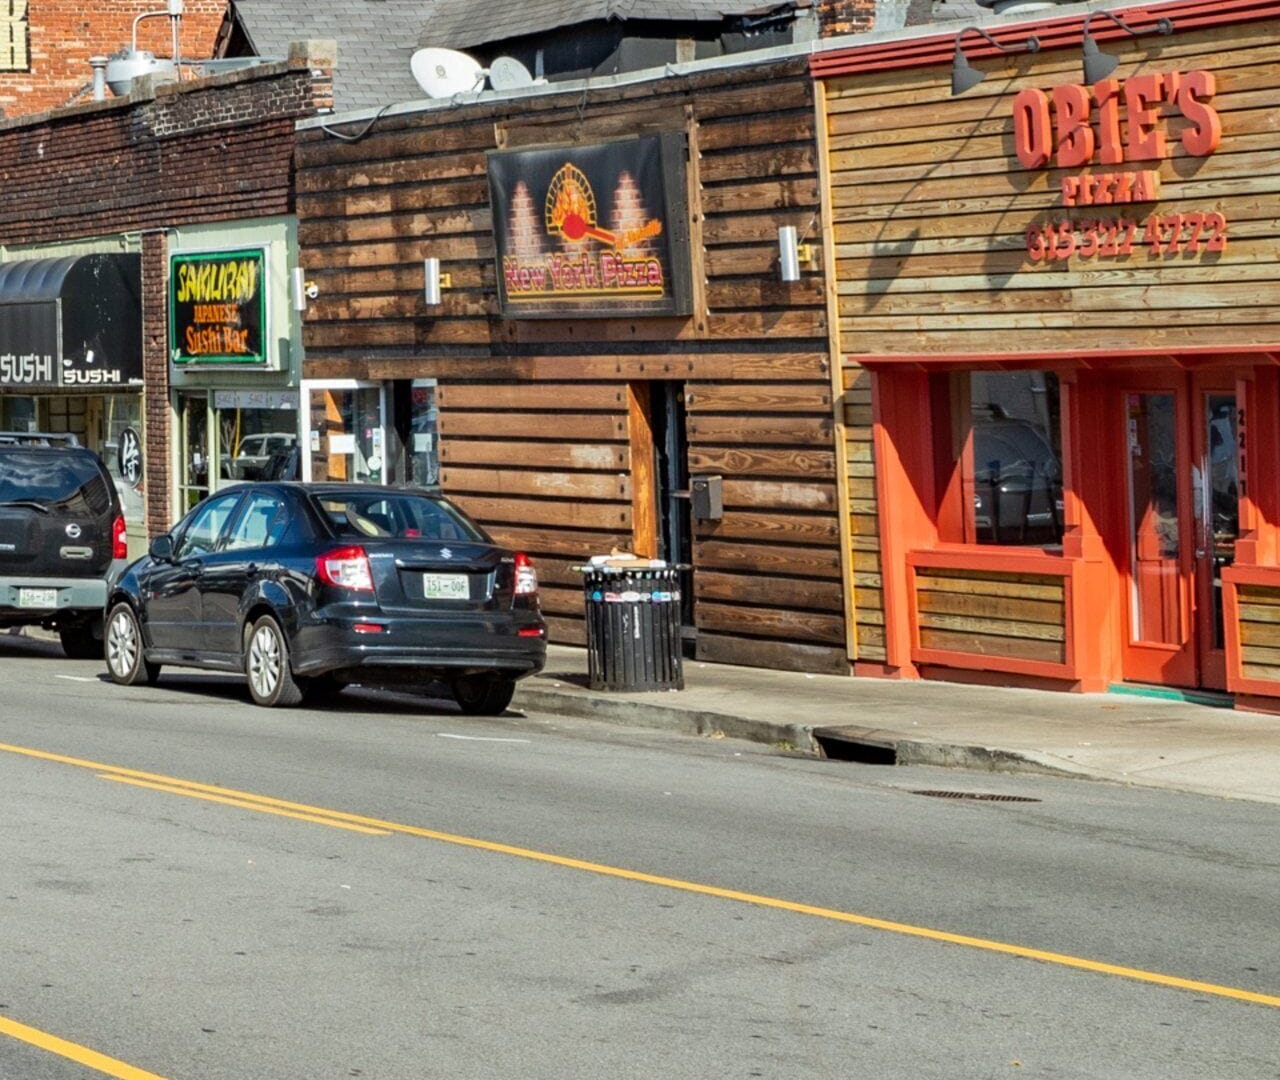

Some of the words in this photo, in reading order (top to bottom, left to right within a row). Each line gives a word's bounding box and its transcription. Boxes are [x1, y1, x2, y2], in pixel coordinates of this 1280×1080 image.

[1013, 70, 1222, 169] OBIE'S
[1061, 170, 1161, 207] PIZZA
[1026, 219, 1076, 261] 615
[1079, 218, 1137, 257] 327
[1143, 211, 1227, 254] 4772
[504, 256, 546, 293] New
[548, 251, 598, 291] York
[602, 251, 663, 289] Pizza
[193, 304, 239, 323] JAPANESE
[186, 325, 222, 354] Sushi
[224, 327, 248, 354] Bar
[0, 353, 52, 383] SUSHI
[63, 369, 121, 384] SUSHI
